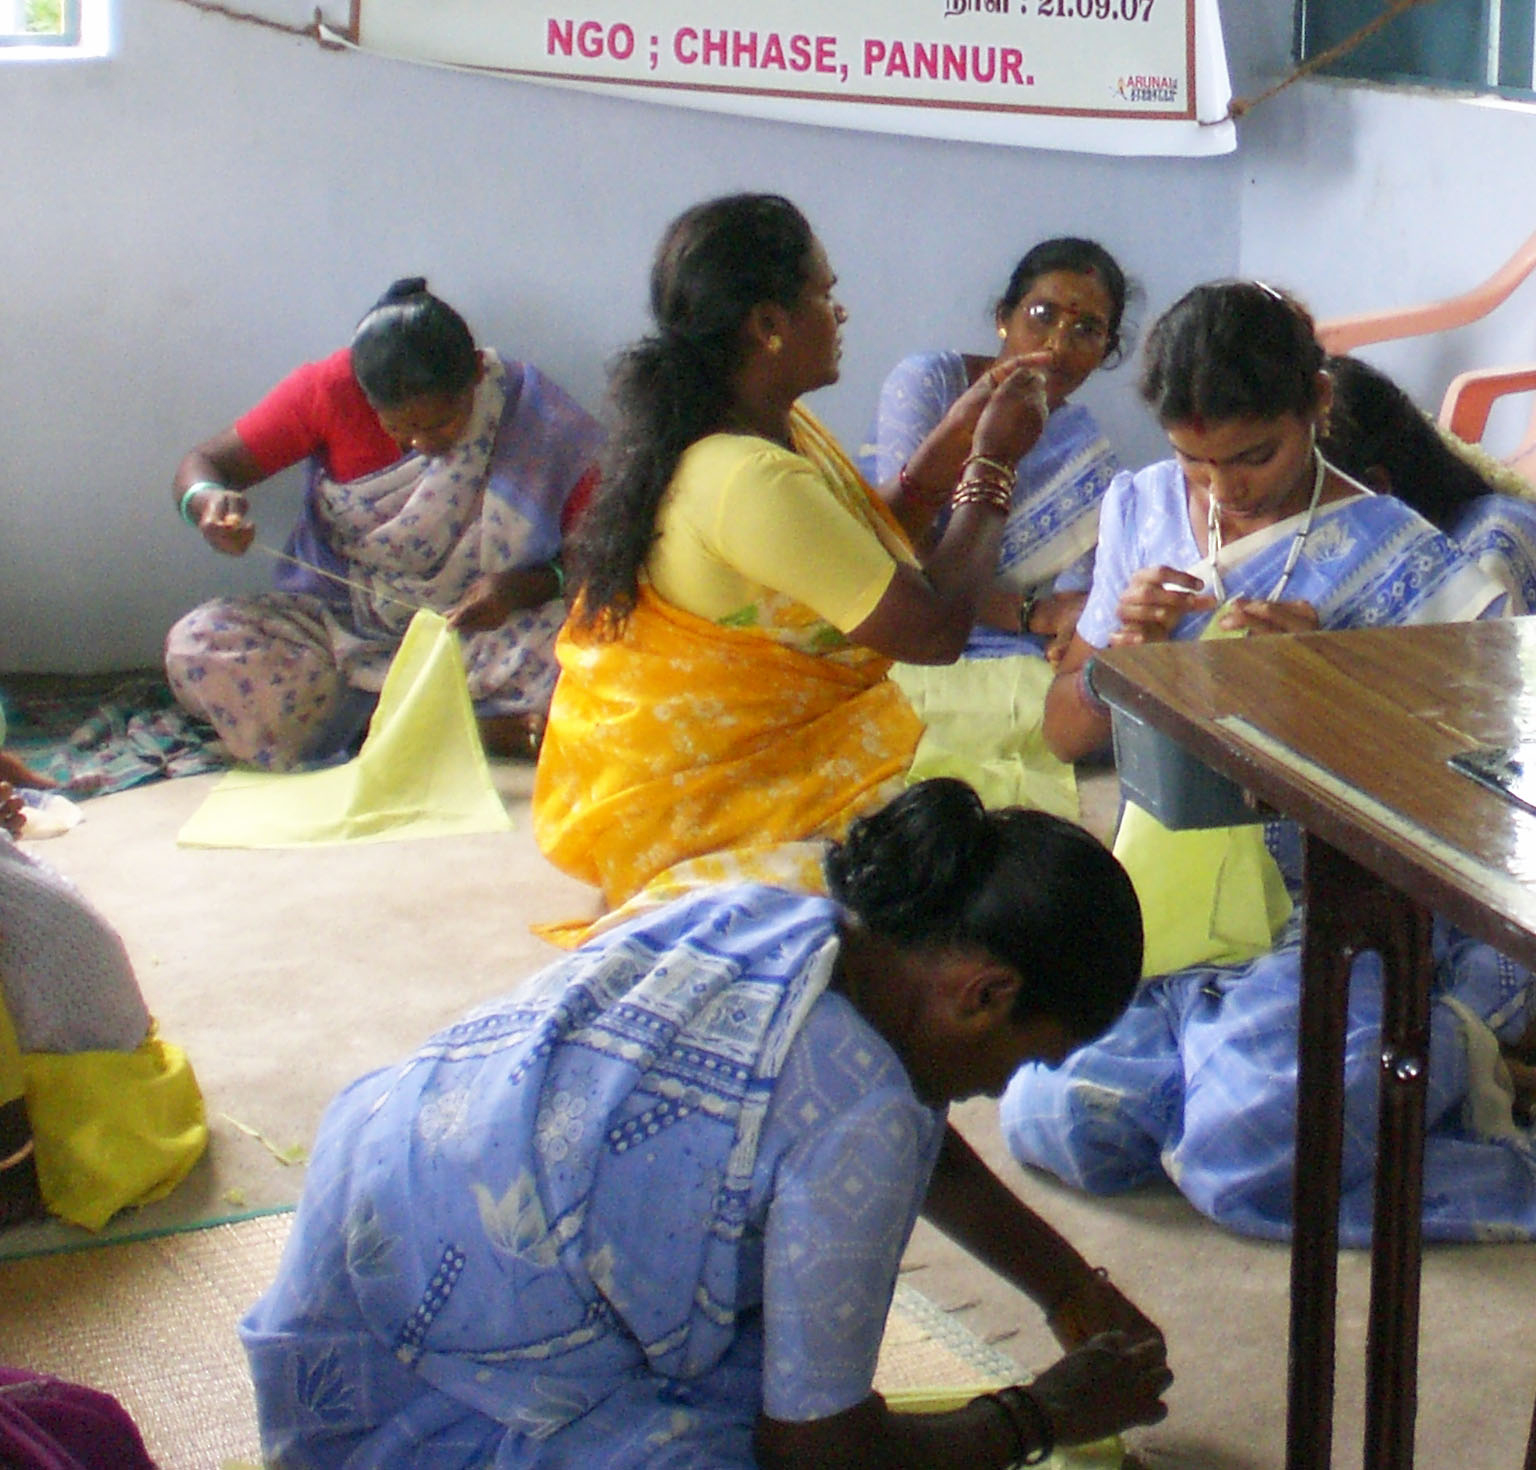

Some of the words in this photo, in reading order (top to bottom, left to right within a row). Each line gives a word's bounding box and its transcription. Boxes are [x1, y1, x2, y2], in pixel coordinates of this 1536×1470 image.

[1037, 0, 1154, 22] 21.09.07
[547, 18, 634, 60] NGO
[650, 36, 658, 70] ;
[674, 27, 848, 82] CHHASE,
[864, 39, 1035, 86] PANNUR.
